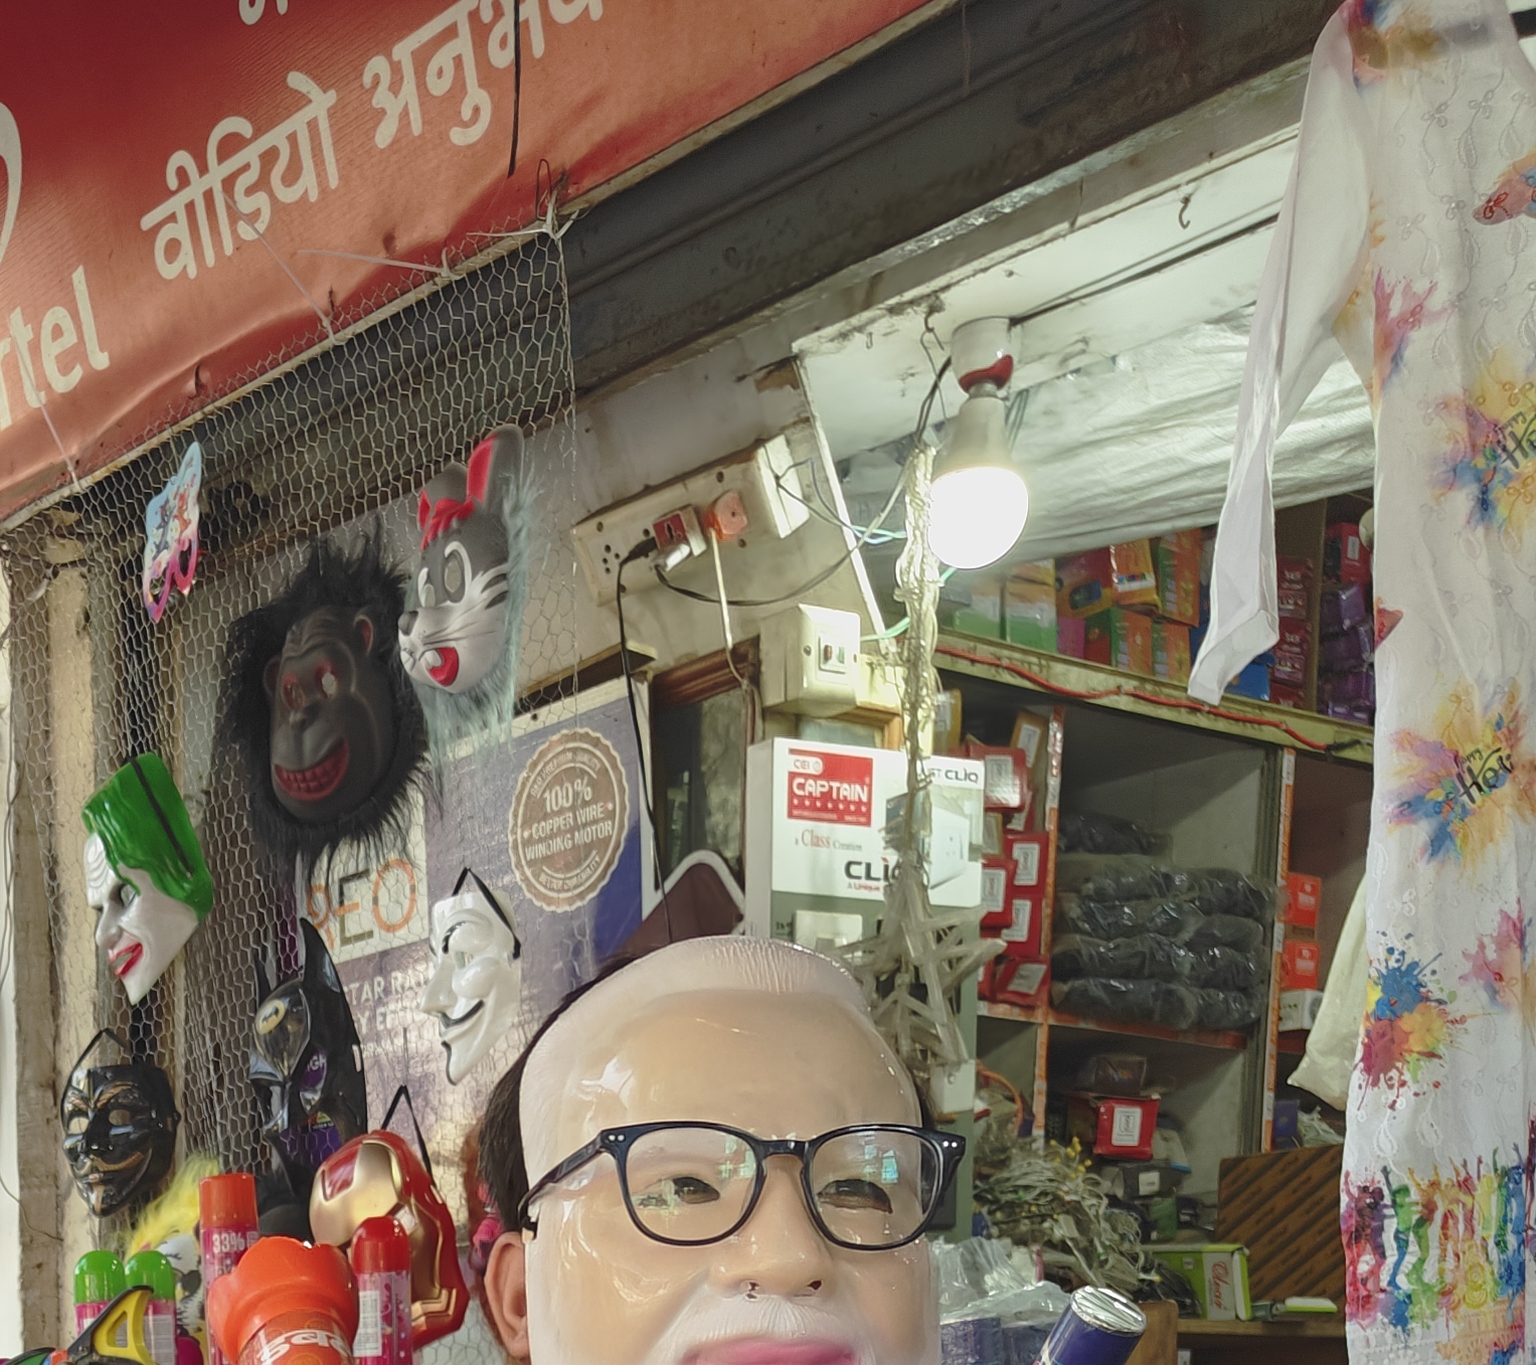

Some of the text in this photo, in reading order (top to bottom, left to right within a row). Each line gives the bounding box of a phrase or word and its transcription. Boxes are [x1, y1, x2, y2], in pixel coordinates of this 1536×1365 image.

[140, 71, 341, 280] वीडियो
[543, 775, 593, 813] 100%
[793, 777, 868, 802] CAPTAIN
[531, 802, 605, 840] COPPER WIRE
[525, 820, 613, 861] WINDING MOTOR
[801, 829, 831, 848] Class
[344, 975, 386, 1006] TAR
[213, 1232, 246, 1253] 33%
